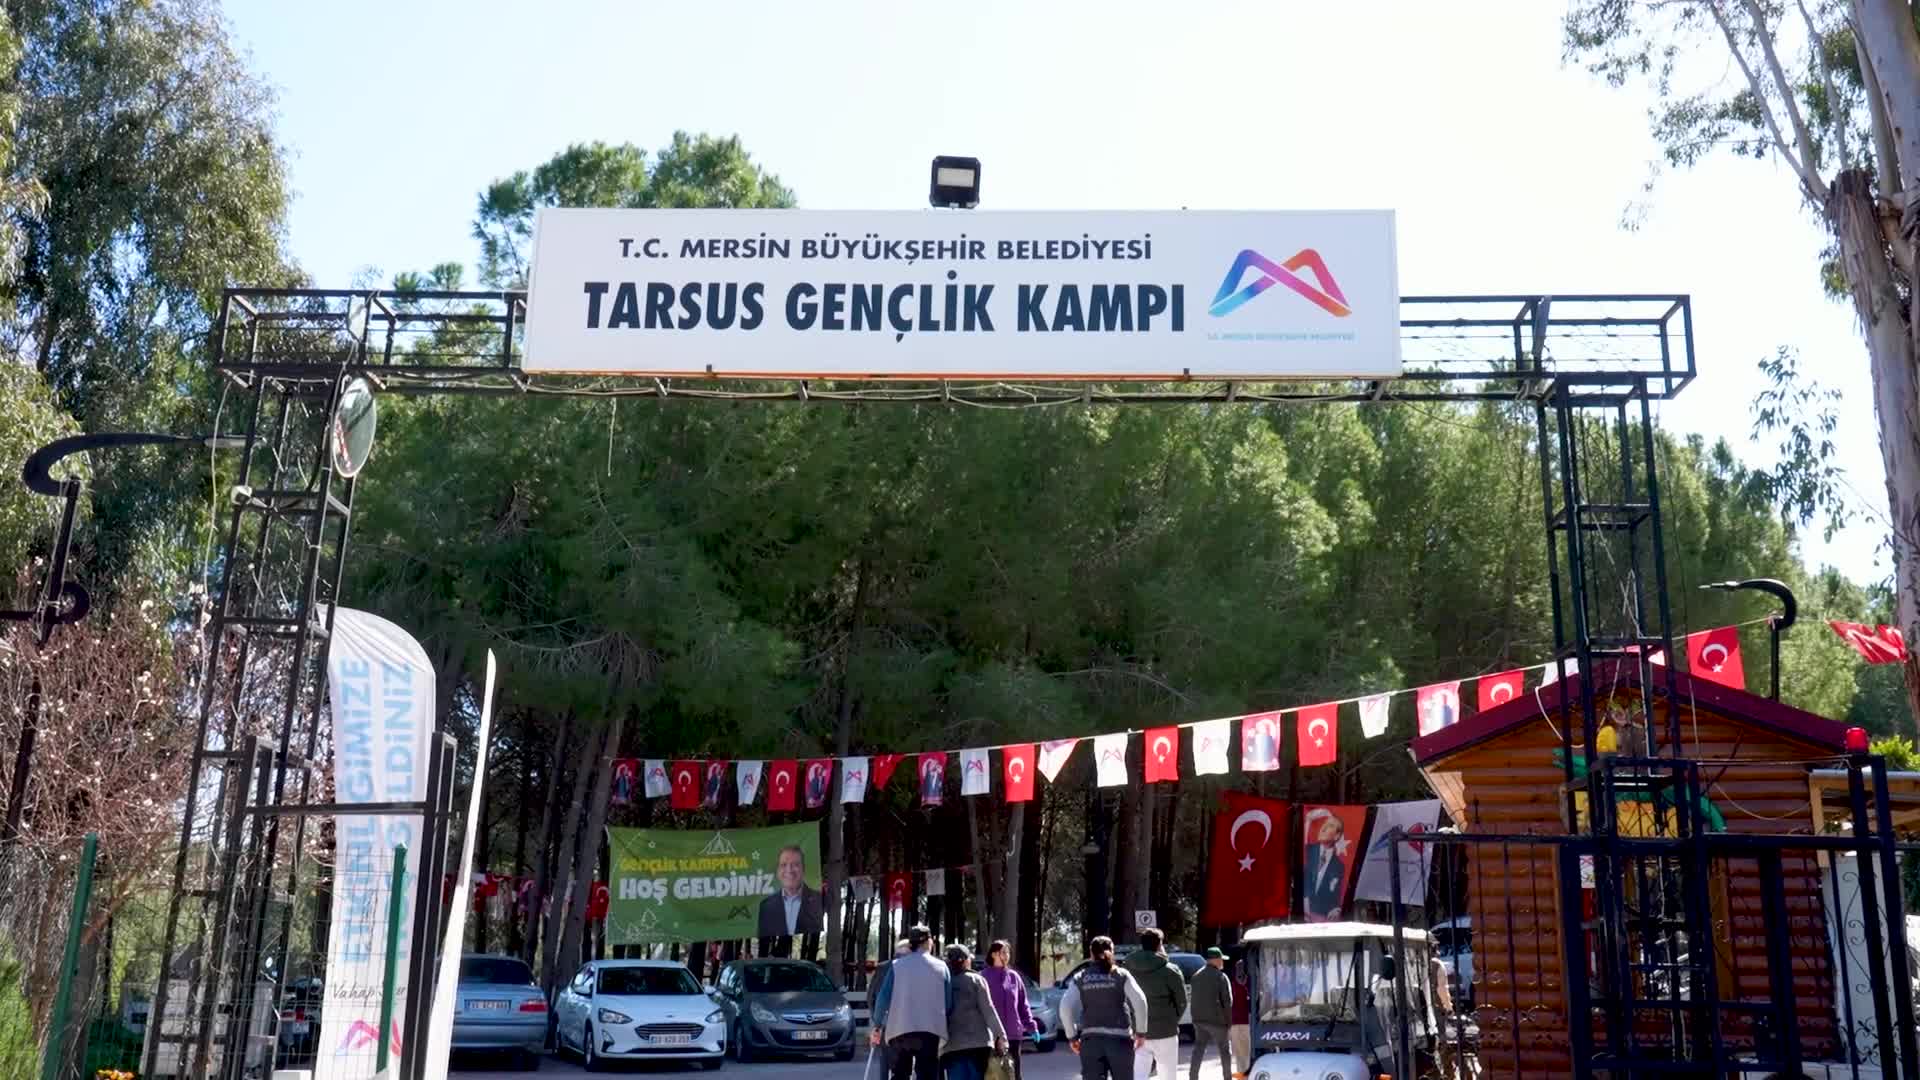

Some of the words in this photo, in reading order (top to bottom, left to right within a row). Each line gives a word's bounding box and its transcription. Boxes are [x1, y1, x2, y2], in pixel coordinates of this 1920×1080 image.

[618, 238, 669, 259] T.C.
[680, 232, 790, 259] MERSİN
[801, 232, 986, 266] BÜYÜKŞEHİR
[997, 232, 1152, 260] BELEDİYESİ
[584, 281, 765, 330] TARSUS
[785, 269, 996, 343] GENÇLİK
[1017, 283, 1185, 332] KAMPI
[619, 877, 669, 905] HOŞ
[673, 869, 775, 899] GELDİNİZ
